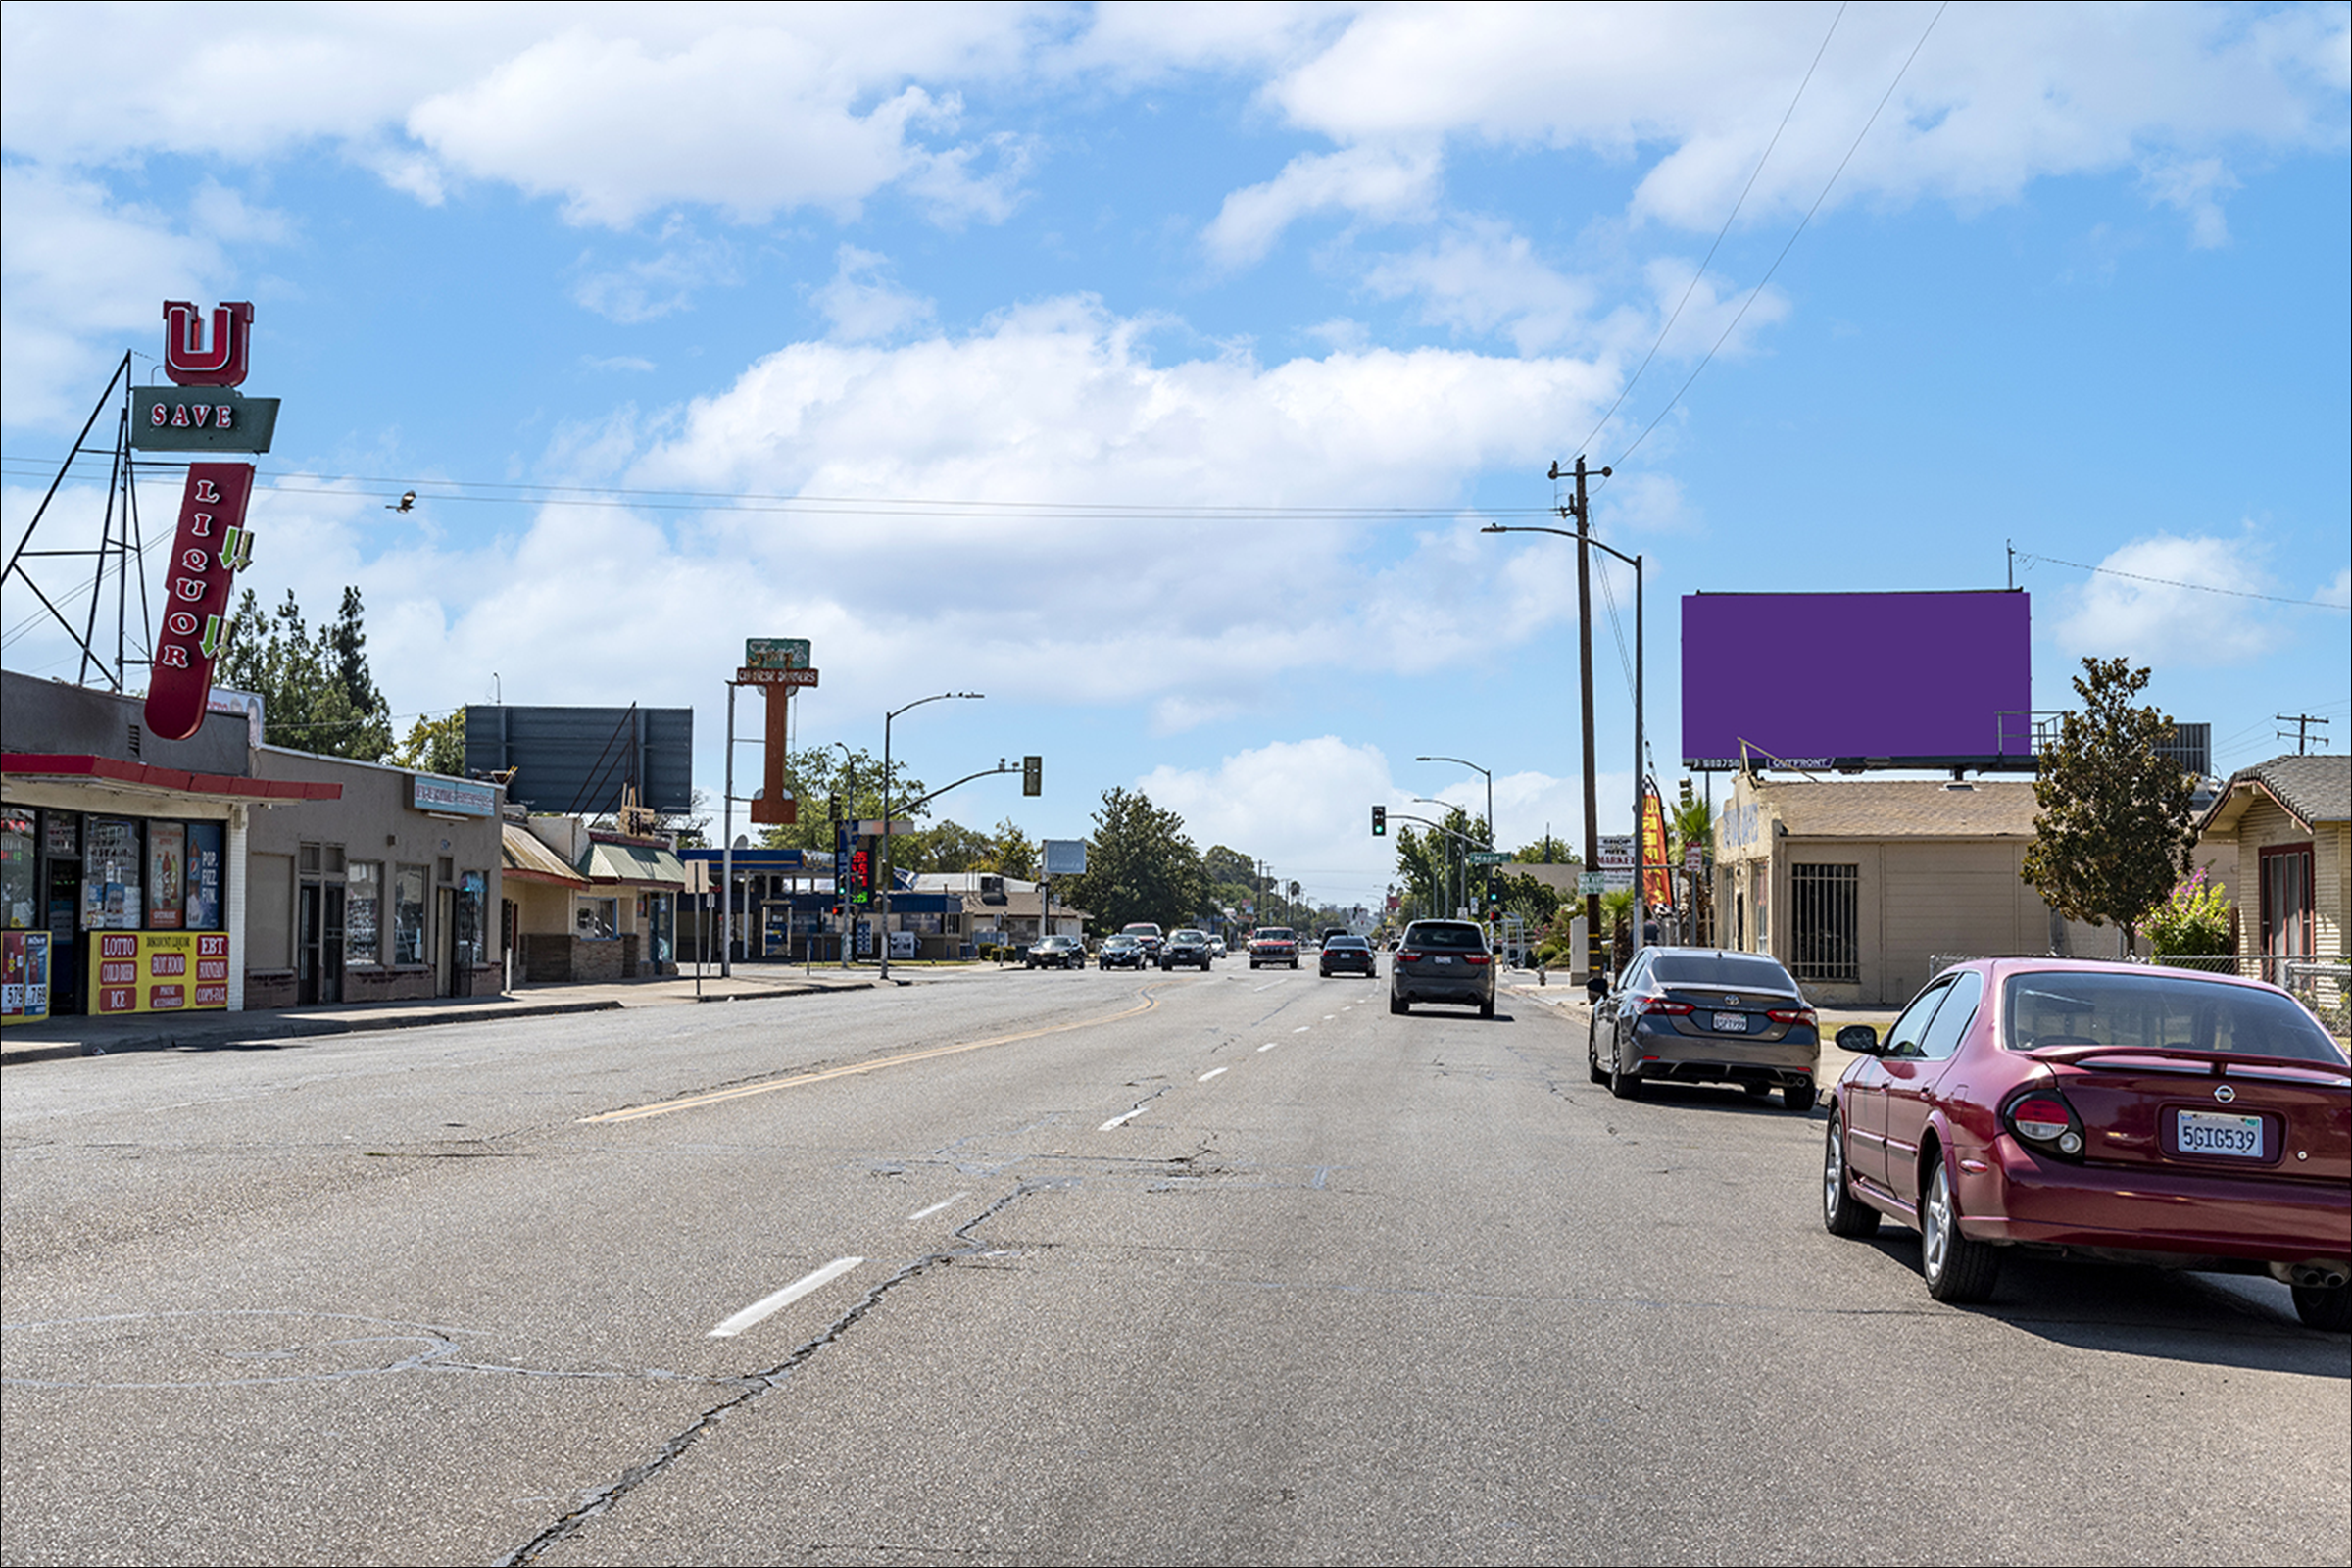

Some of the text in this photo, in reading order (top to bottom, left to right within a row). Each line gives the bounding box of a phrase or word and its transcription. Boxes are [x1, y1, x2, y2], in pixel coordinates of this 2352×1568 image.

[164, 300, 253, 386] U
[152, 403, 231, 427] SAVE
[162, 479, 220, 668] LIQUOR
[1772, 758, 1828, 768] OUTFRONT
[104, 937, 135, 956] LOTTO
[200, 937, 224, 955] EBT
[103, 964, 134, 982] COLD BEER
[152, 956, 185, 973] HOT FOOD
[111, 991, 126, 1008] ICE
[2183, 1126, 2256, 1151] 5GIG539
